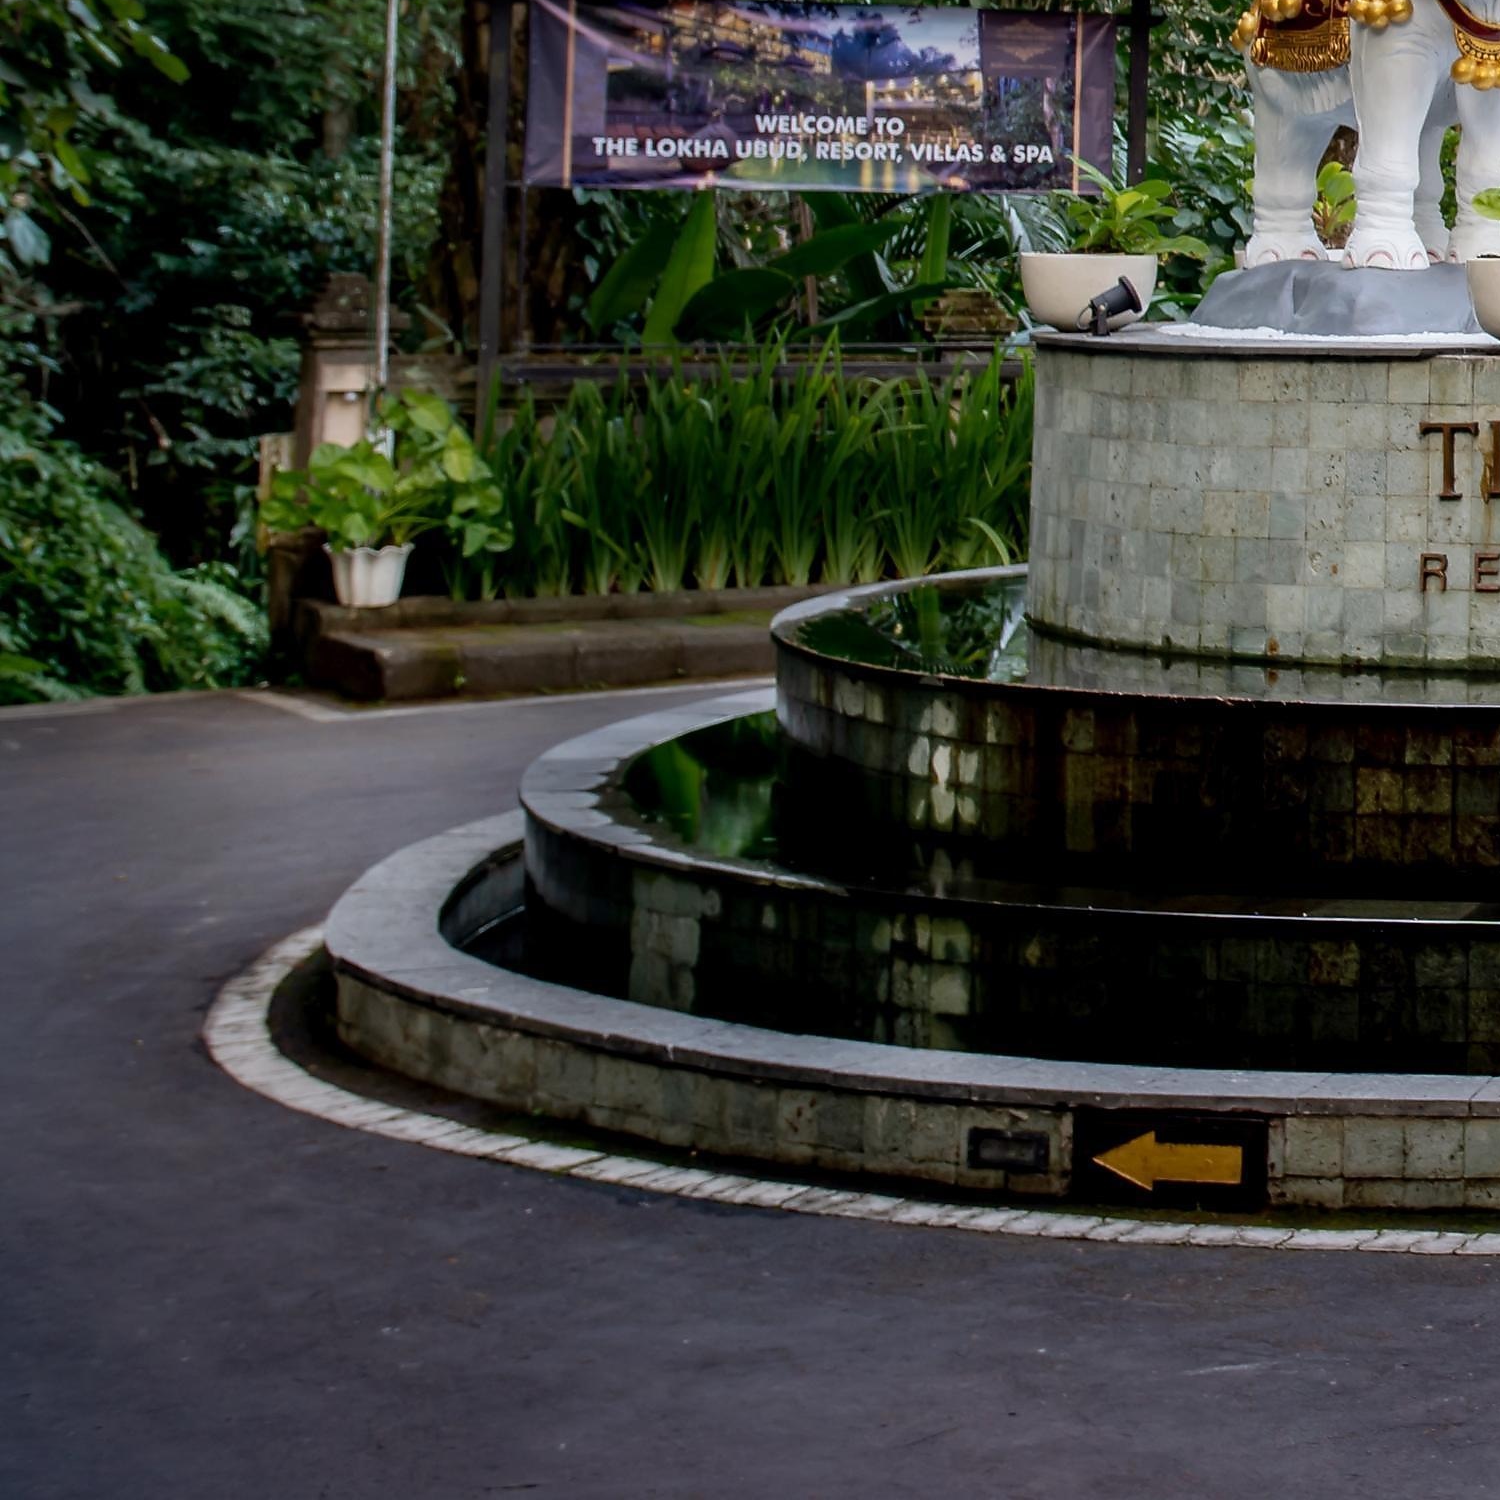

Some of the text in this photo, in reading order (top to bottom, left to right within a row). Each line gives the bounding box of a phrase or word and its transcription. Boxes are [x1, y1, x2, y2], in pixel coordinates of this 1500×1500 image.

[755, 114, 905, 136] WELCOME TO
[592, 137, 1053, 164] THE LOKHA UBUD, RESORT, VILLAS & SPA
